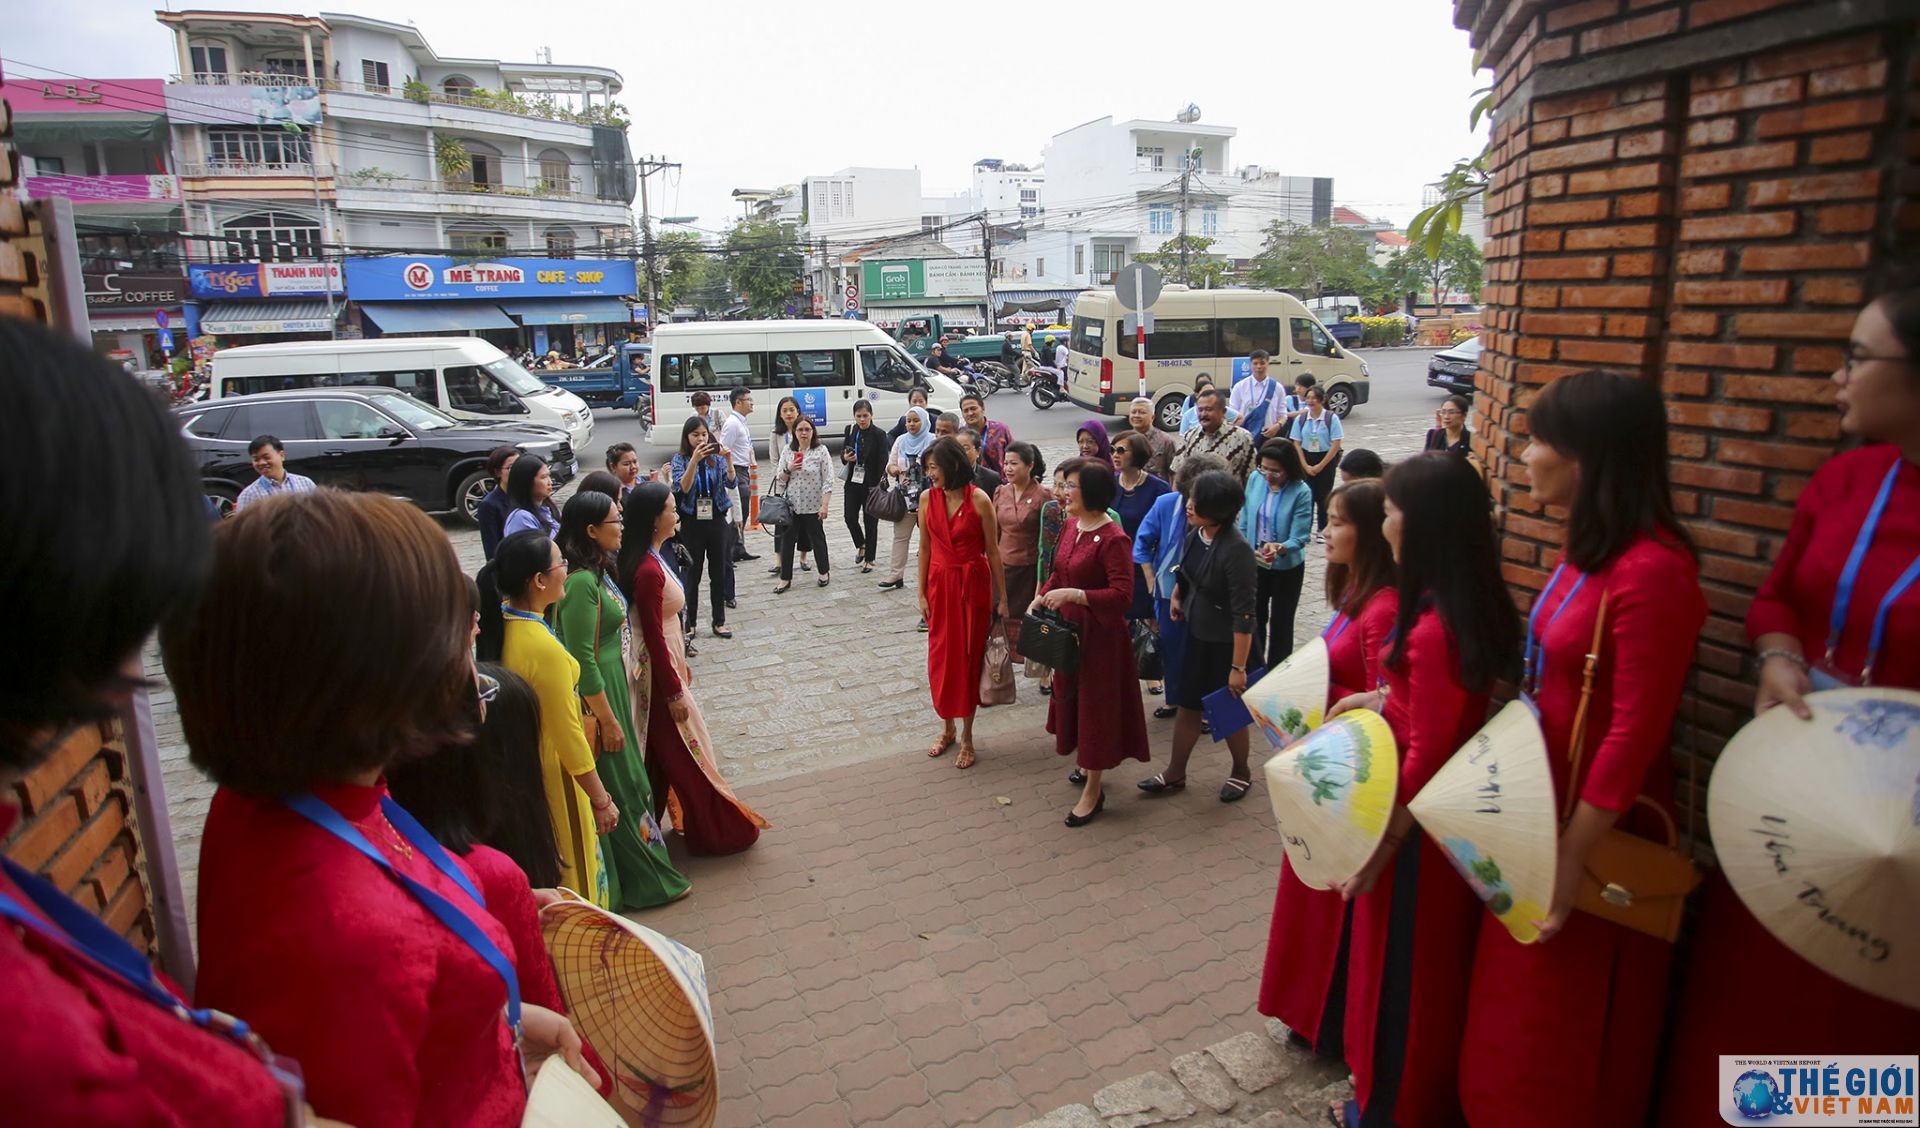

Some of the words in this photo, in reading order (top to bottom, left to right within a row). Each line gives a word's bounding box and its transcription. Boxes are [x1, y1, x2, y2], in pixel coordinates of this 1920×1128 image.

[272, 267, 306, 278] THANH
[450, 270, 473, 282] ME
[477, 270, 521, 282] TRANG
[537, 271, 566, 283] CAFE
[576, 271, 604, 283] SHOP
[206, 271, 255, 293] Tiger
[885, 275, 906, 283] Grab
[125, 291, 175, 302] COFFEE
